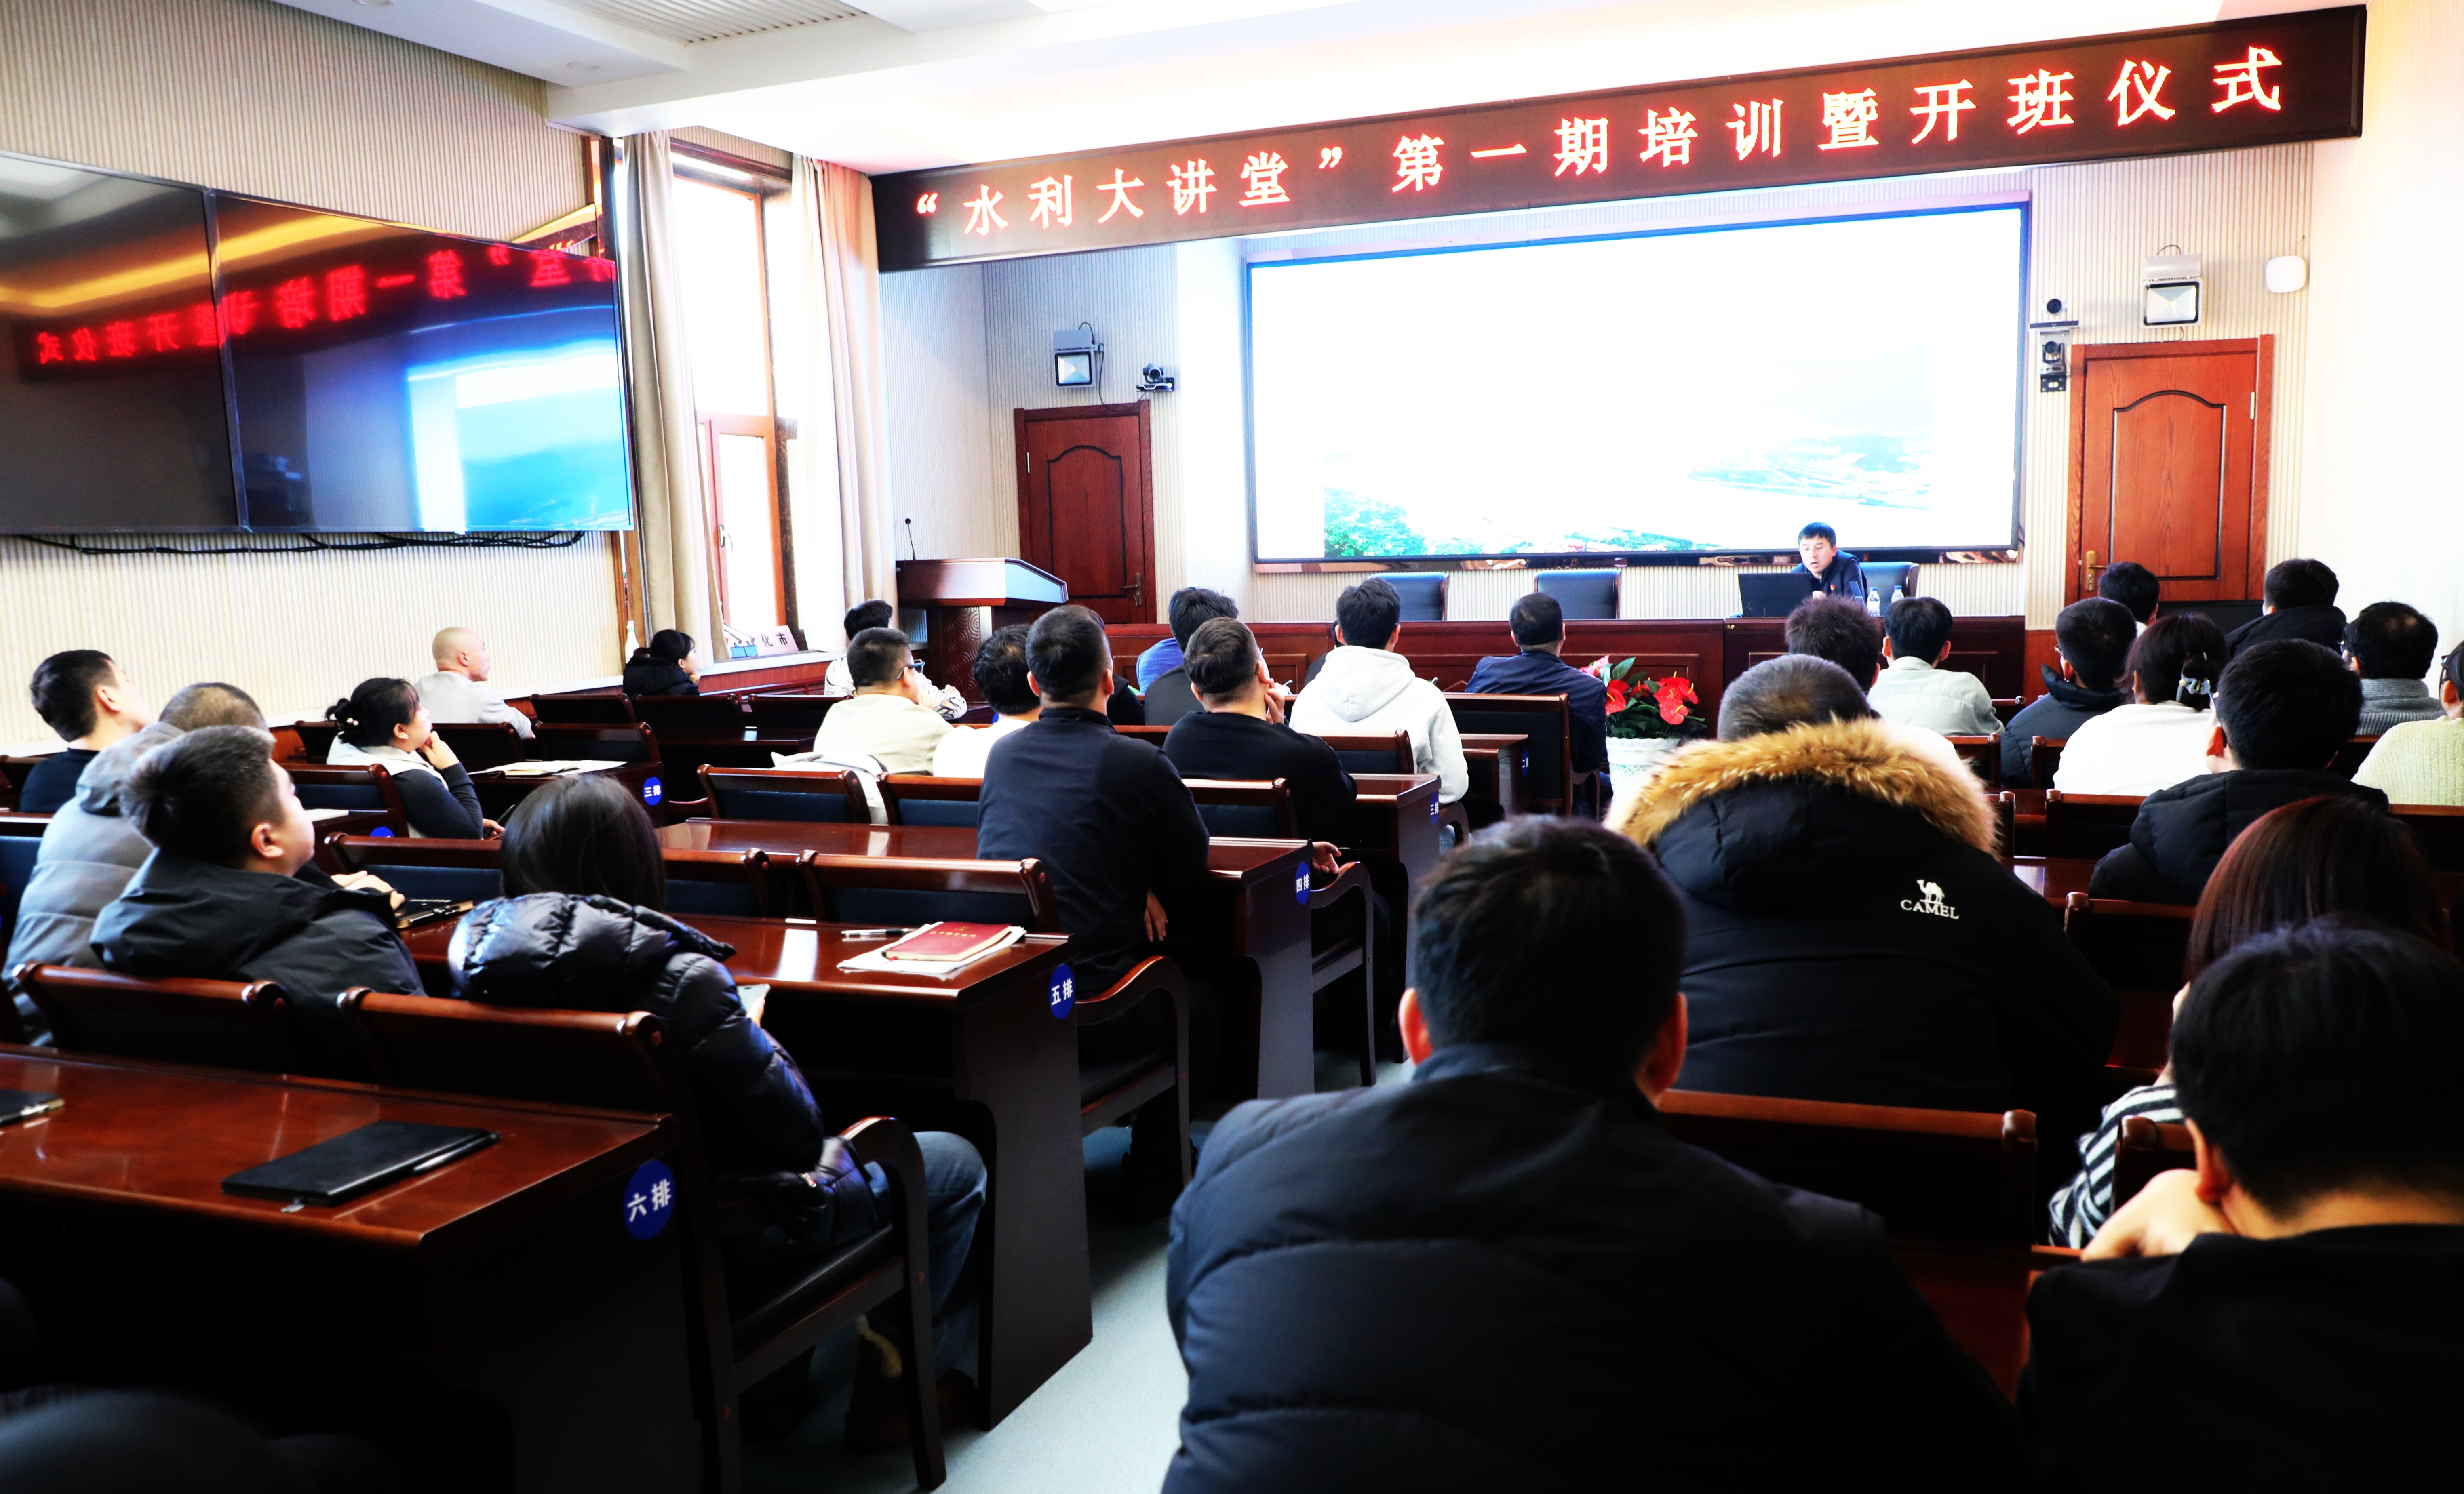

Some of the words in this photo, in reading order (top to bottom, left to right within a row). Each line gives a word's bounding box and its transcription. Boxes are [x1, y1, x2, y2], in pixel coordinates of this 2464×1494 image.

[645, 785, 661, 798] 三排
[1430, 802, 1439, 815] 三排
[1296, 873, 1310, 893] 四排
[1900, 899, 1959, 919] CAMEL
[1051, 978, 1073, 1006] 五排
[628, 1179, 671, 1222] 六排
